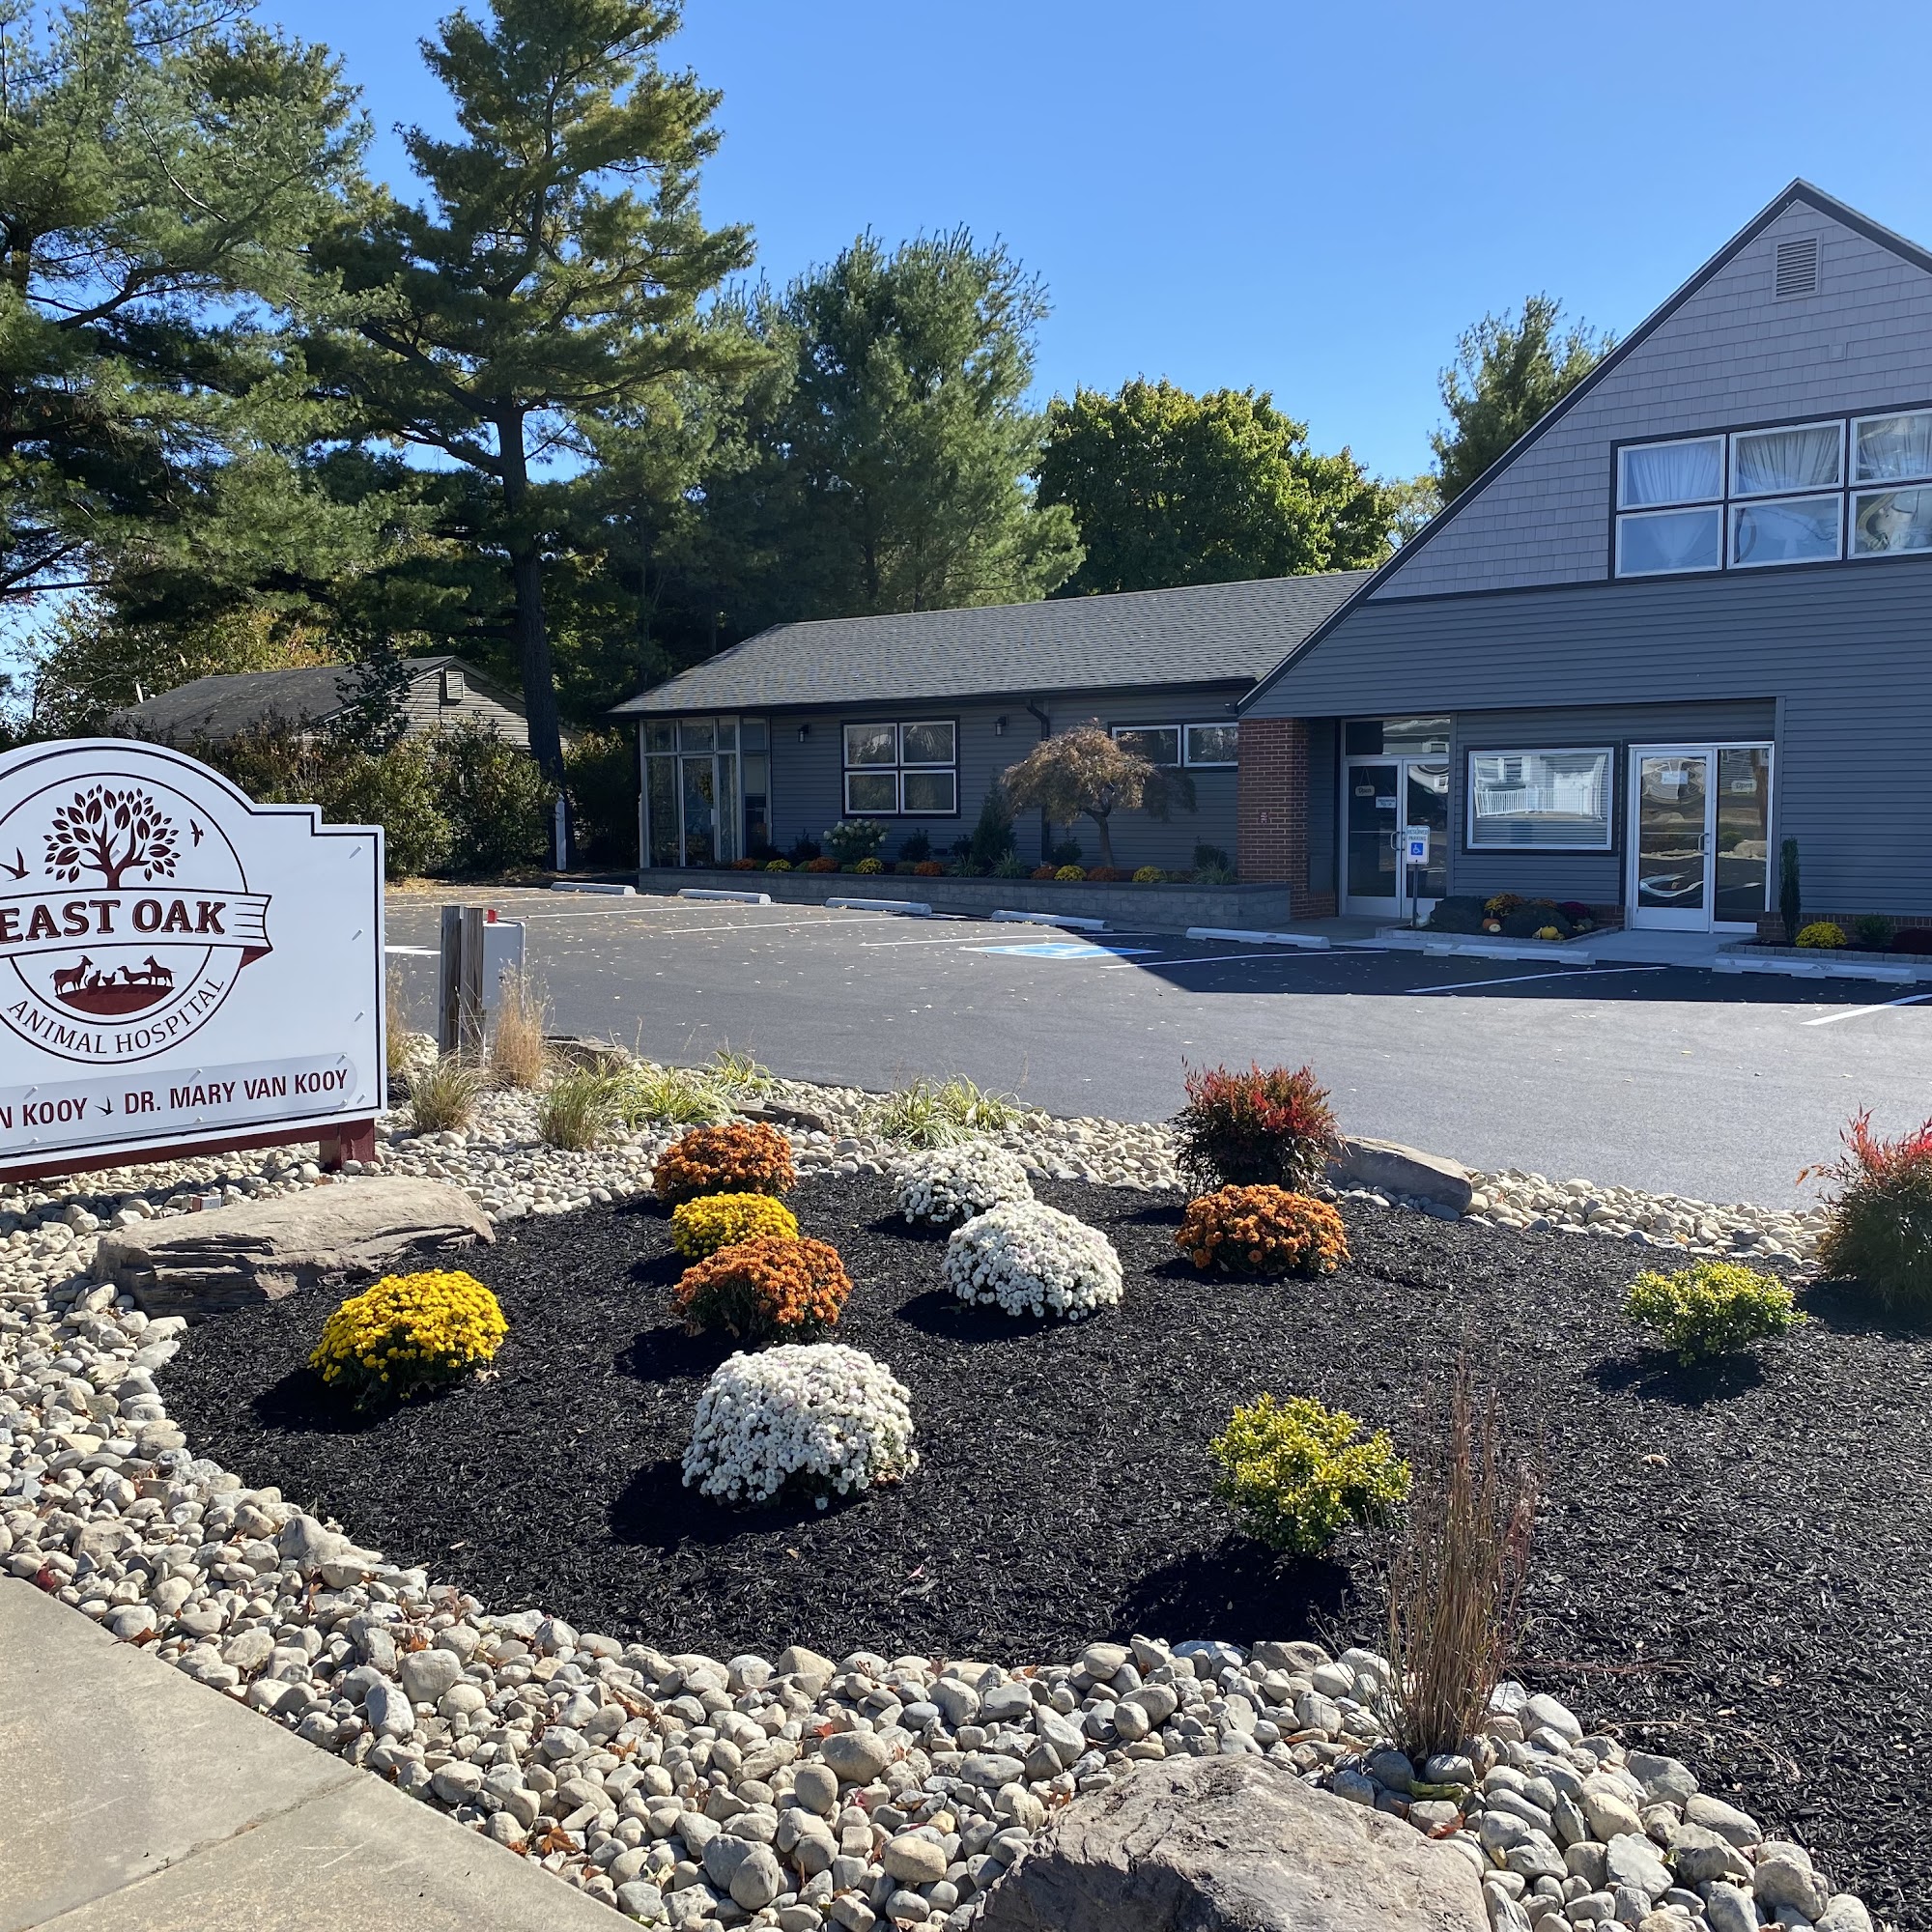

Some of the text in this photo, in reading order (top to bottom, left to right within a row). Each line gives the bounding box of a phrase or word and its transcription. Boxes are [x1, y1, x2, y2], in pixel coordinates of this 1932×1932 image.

[0, 898, 226, 945] EAST OAK
[7, 978, 224, 1054] ANIMAL HOSPITAL
[23, 1097, 88, 1126] KOOY
[125, 1091, 161, 1115] DR.
[170, 1081, 236, 1109] MARY
[243, 1075, 286, 1100] VAN
[295, 1068, 348, 1094] KOOY
